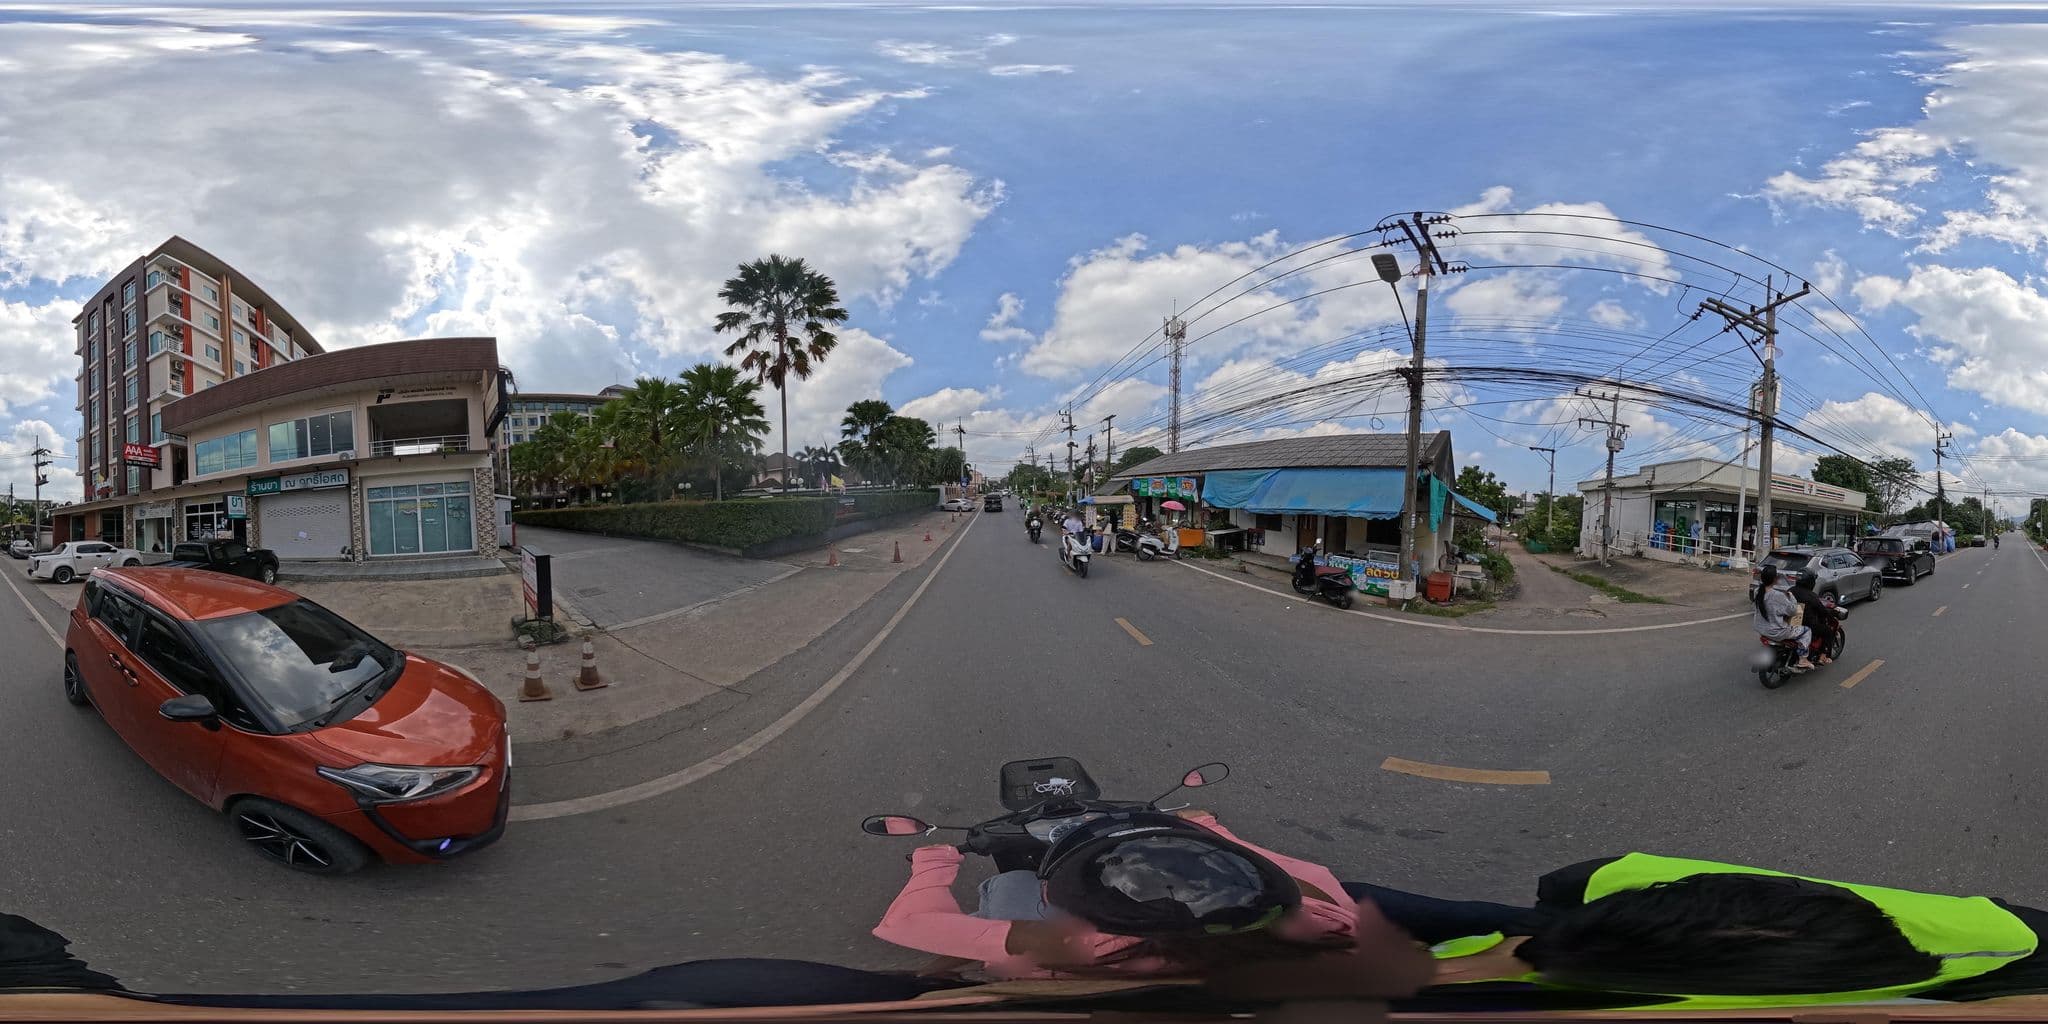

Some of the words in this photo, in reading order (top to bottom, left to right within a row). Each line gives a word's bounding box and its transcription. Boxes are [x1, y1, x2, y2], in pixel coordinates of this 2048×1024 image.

[125, 445, 143, 456] AAA
[250, 480, 278, 492] ร้านยา
[231, 496, 243, 508] ยา
